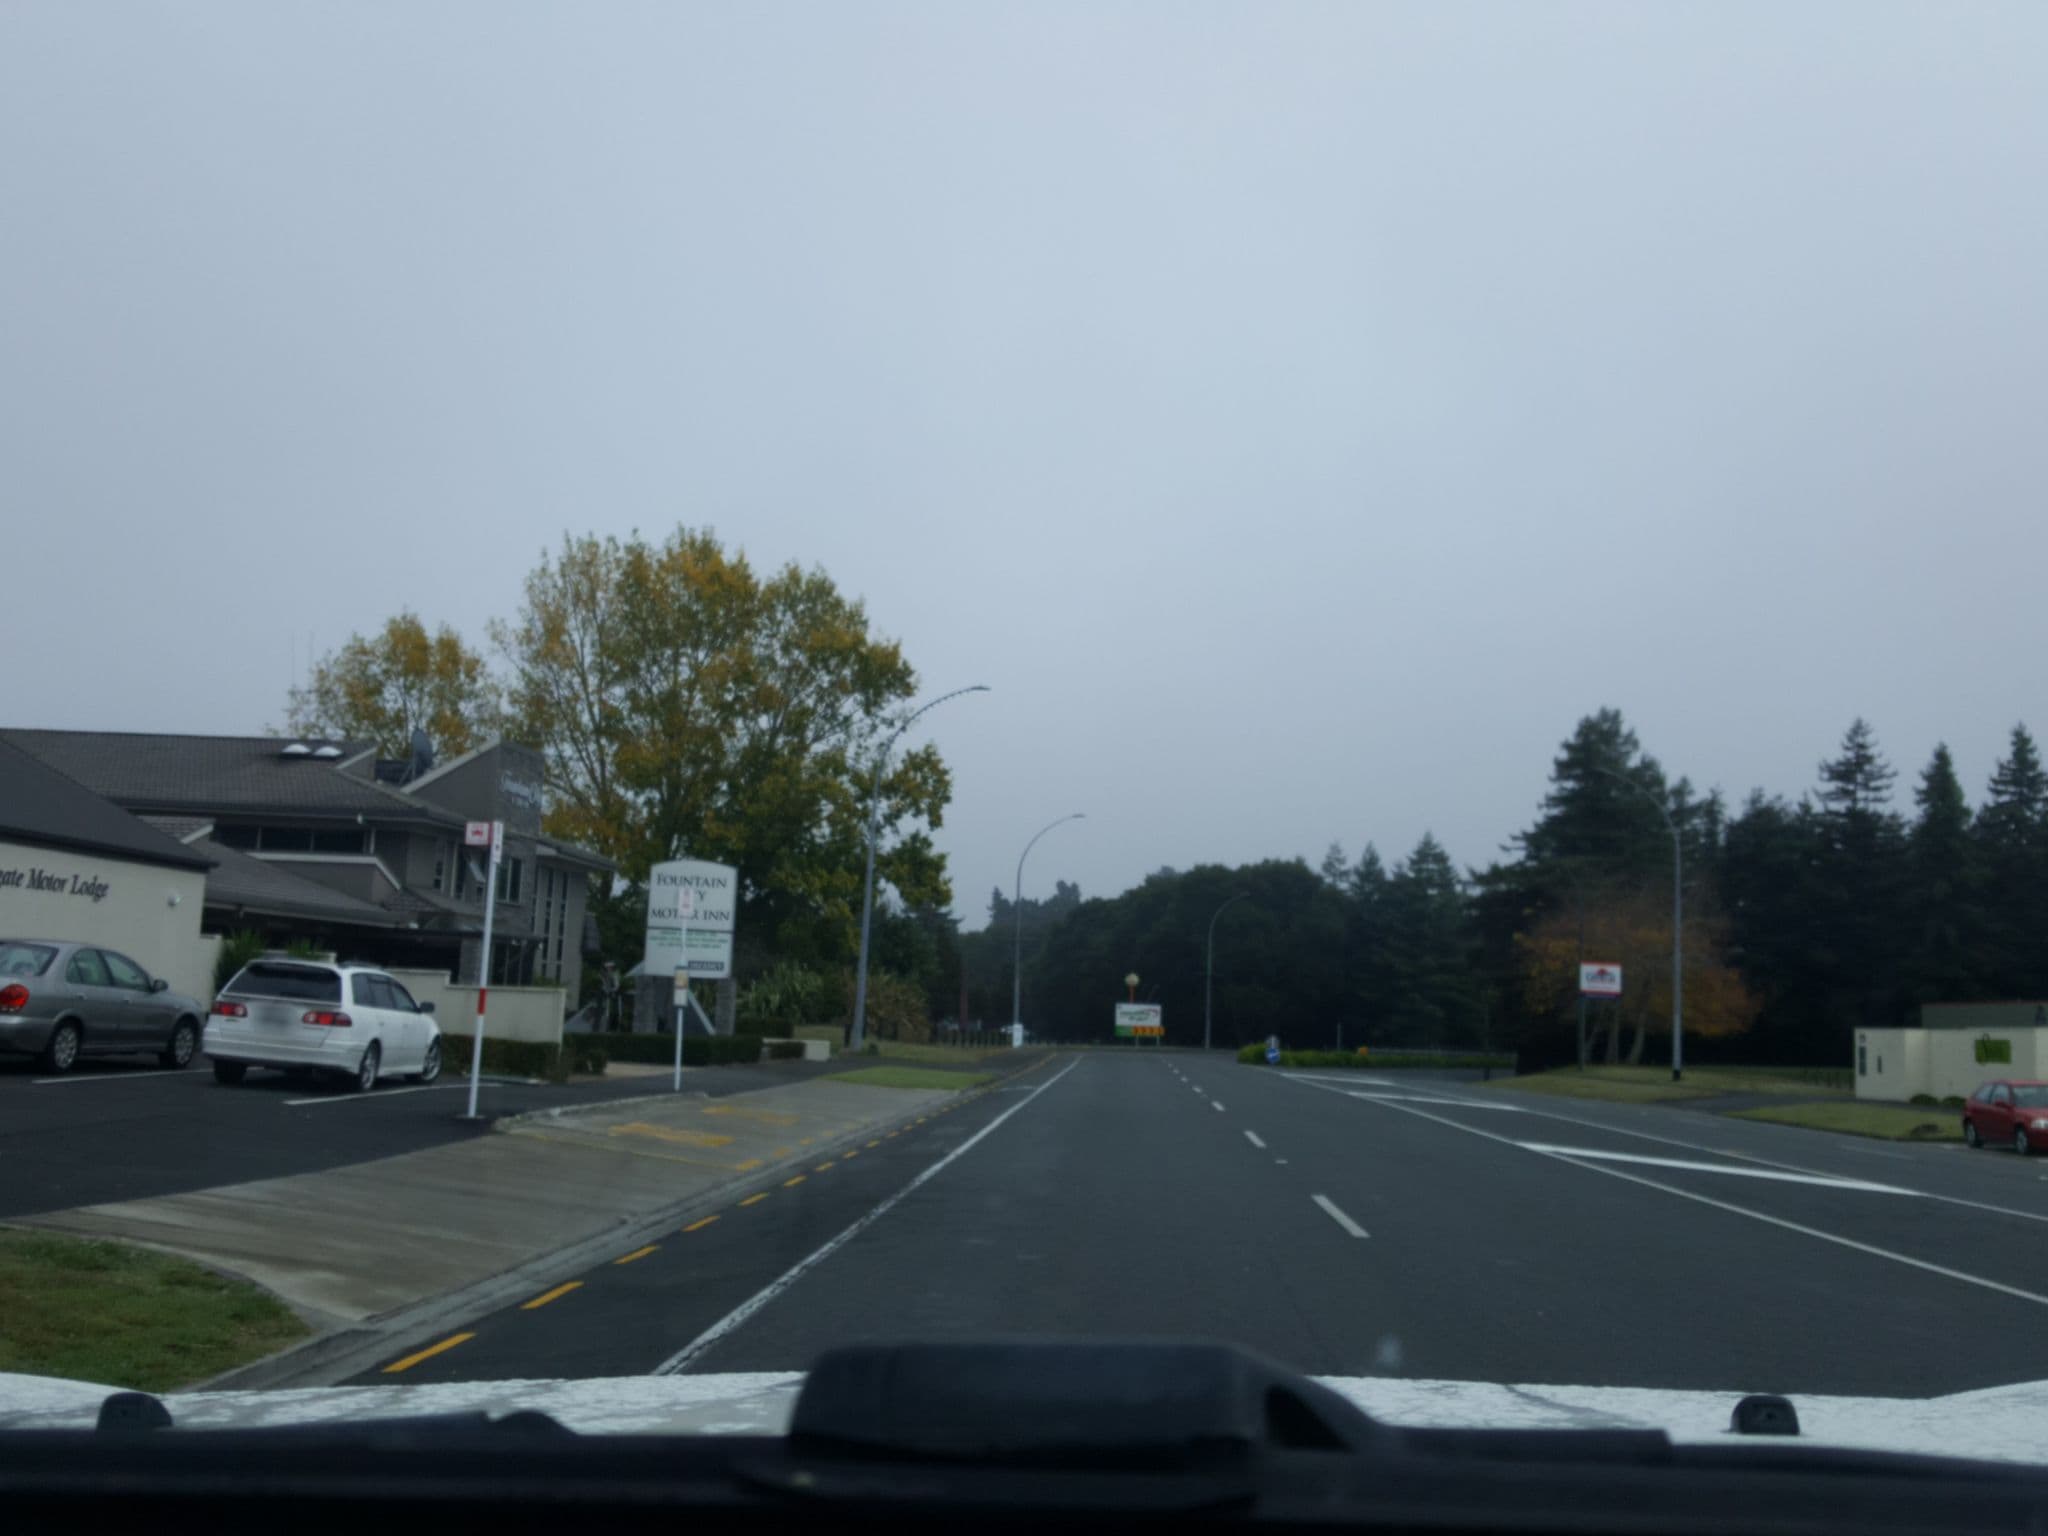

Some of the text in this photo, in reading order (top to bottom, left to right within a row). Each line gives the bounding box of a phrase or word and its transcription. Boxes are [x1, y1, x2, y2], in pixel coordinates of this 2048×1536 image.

[26, 867, 68, 892] Motor
[70, 874, 109, 903] Lodge
[656, 873, 728, 889] FOUNTAIN
[703, 910, 730, 921] INN
